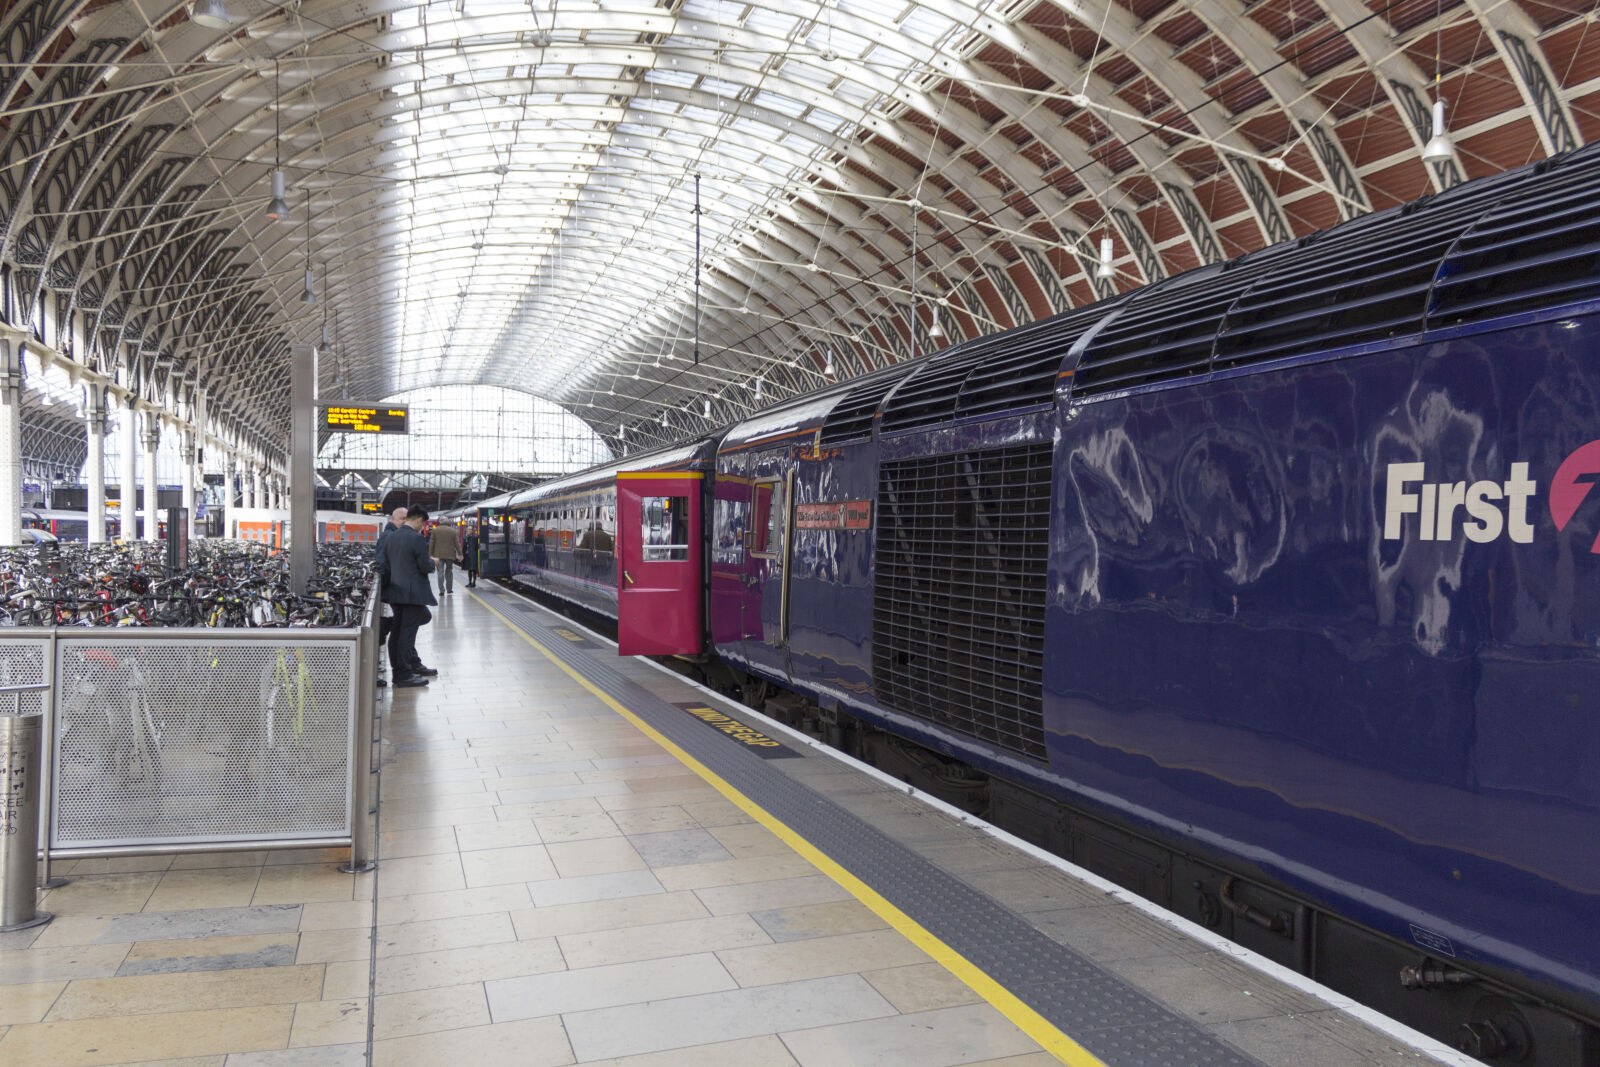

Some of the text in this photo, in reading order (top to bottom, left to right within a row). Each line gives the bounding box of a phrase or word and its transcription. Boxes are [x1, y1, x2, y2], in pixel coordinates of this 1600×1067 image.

[1384, 462, 1537, 543] First
[685, 708, 780, 747] MIND THE GAP
[0, 798, 24, 807] REE
